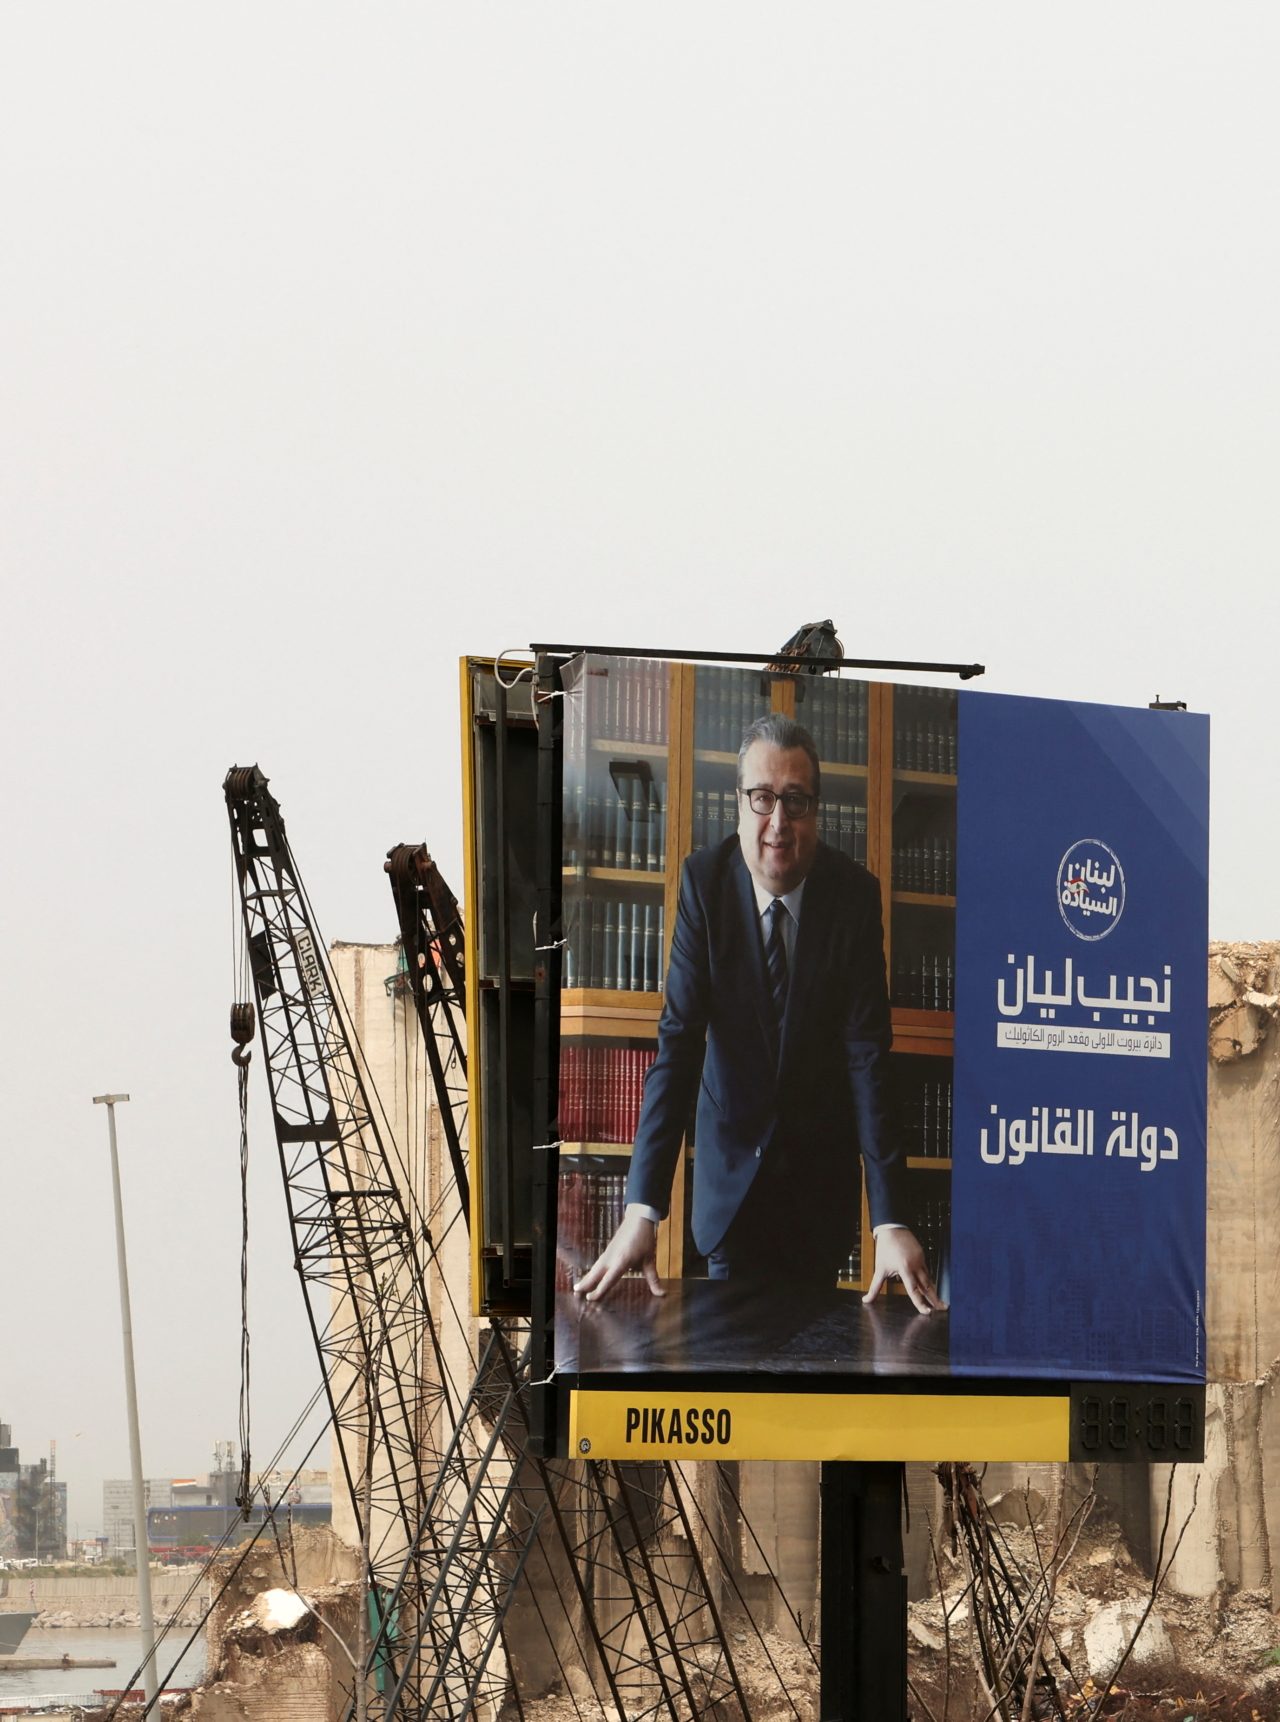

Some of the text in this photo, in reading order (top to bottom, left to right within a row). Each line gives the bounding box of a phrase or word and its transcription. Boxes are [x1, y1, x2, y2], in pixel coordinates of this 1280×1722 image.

[1068, 859, 1115, 893] لبنان
[1062, 881, 1117, 916] السيادة
[298, 936, 321, 992] CLARK
[998, 954, 1172, 1025] نجيب ليان
[1005, 1026, 1045, 1045] الكاثوليك
[1046, 1029, 1065, 1049] الروم
[1068, 1031, 1090, 1047] مقعد
[1117, 1037, 1142, 1052] بيروت
[1144, 1035, 1162, 1053] دائرة
[981, 1105, 1179, 1172] دولة القانون
[625, 1407, 731, 1445] PIKASSO
